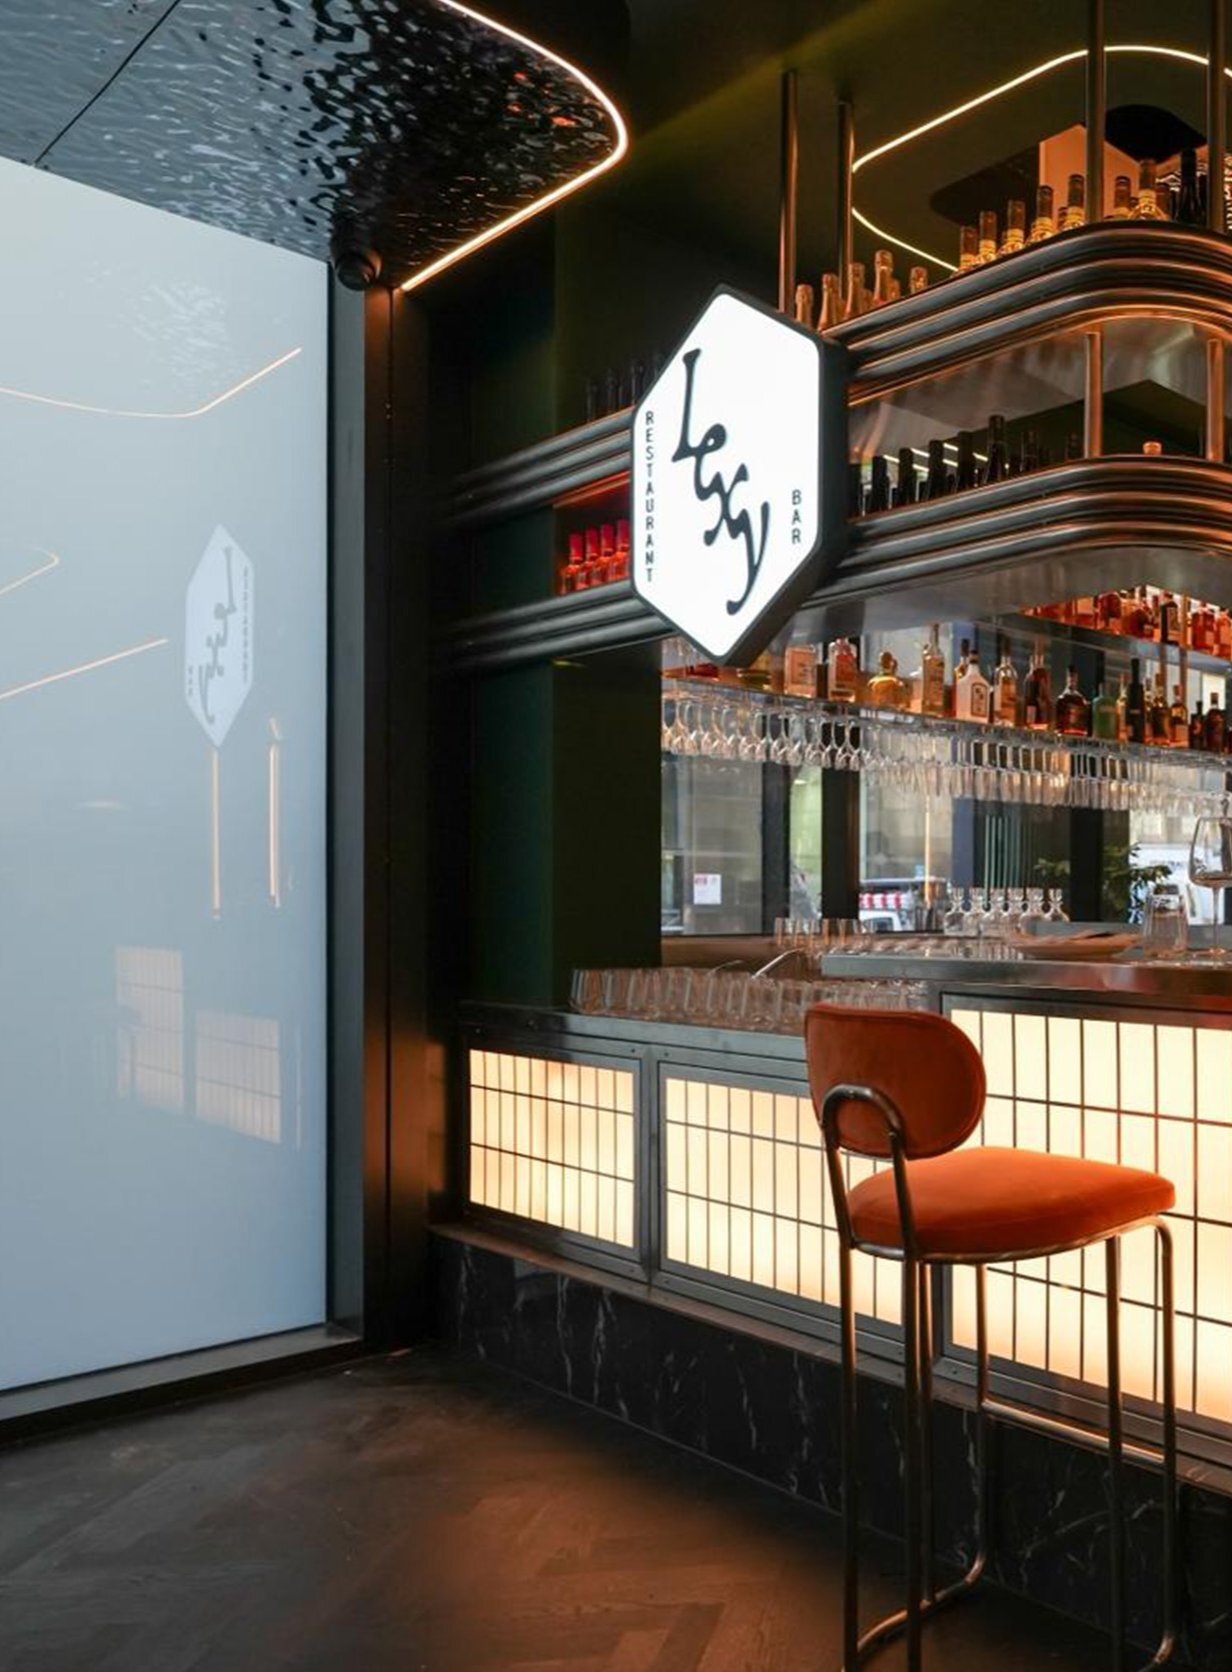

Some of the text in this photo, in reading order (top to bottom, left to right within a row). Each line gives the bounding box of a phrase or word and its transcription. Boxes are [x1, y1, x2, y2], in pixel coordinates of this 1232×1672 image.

[644, 410, 655, 583] RESTAURANT
[671, 347, 770, 617] Lexy
[791, 488, 802, 545] BAR
